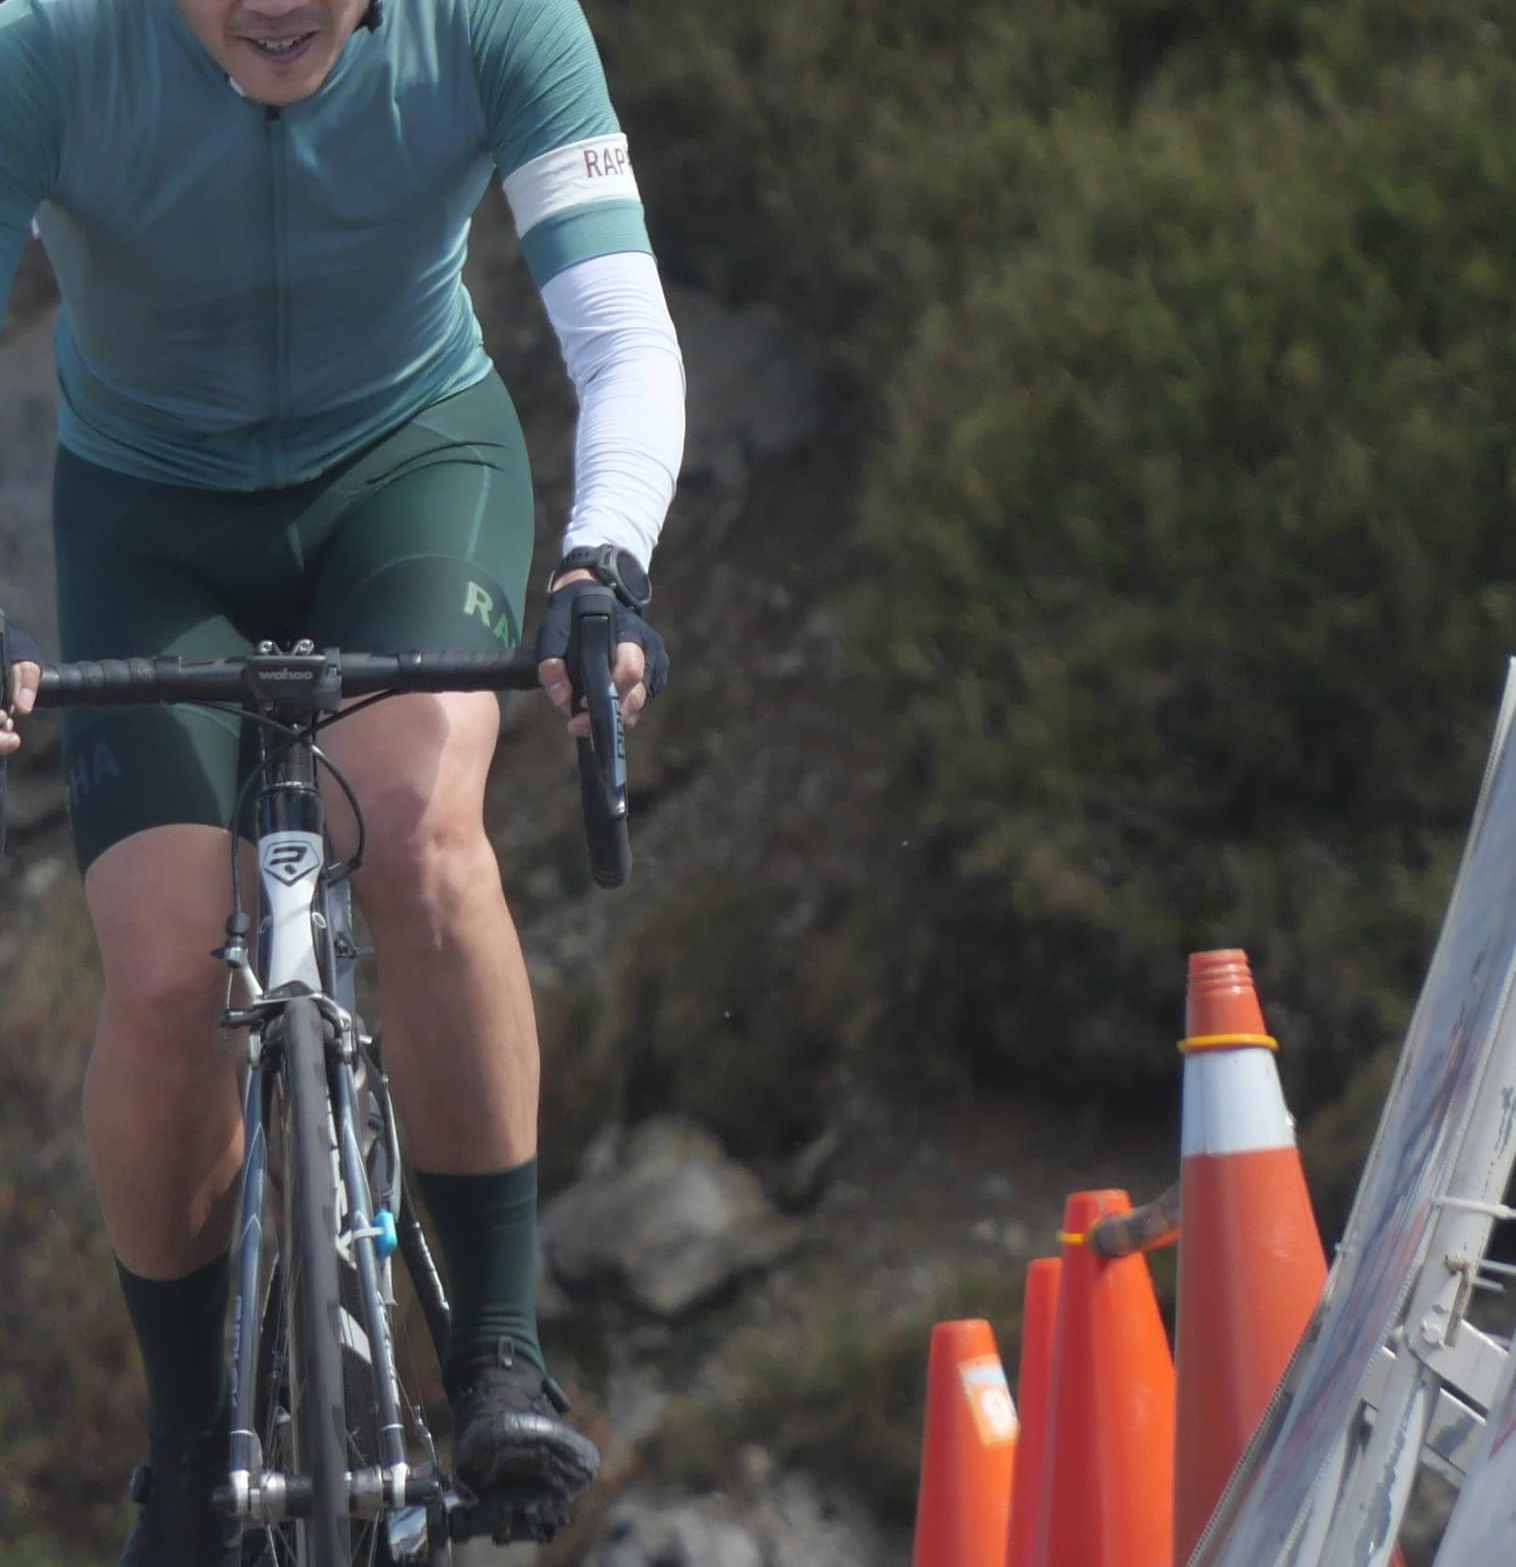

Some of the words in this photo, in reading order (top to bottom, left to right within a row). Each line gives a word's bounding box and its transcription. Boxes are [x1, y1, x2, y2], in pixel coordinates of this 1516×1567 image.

[583, 147, 630, 179] RAP
[464, 580, 517, 649] RA
[258, 667, 314, 681] wahoo
